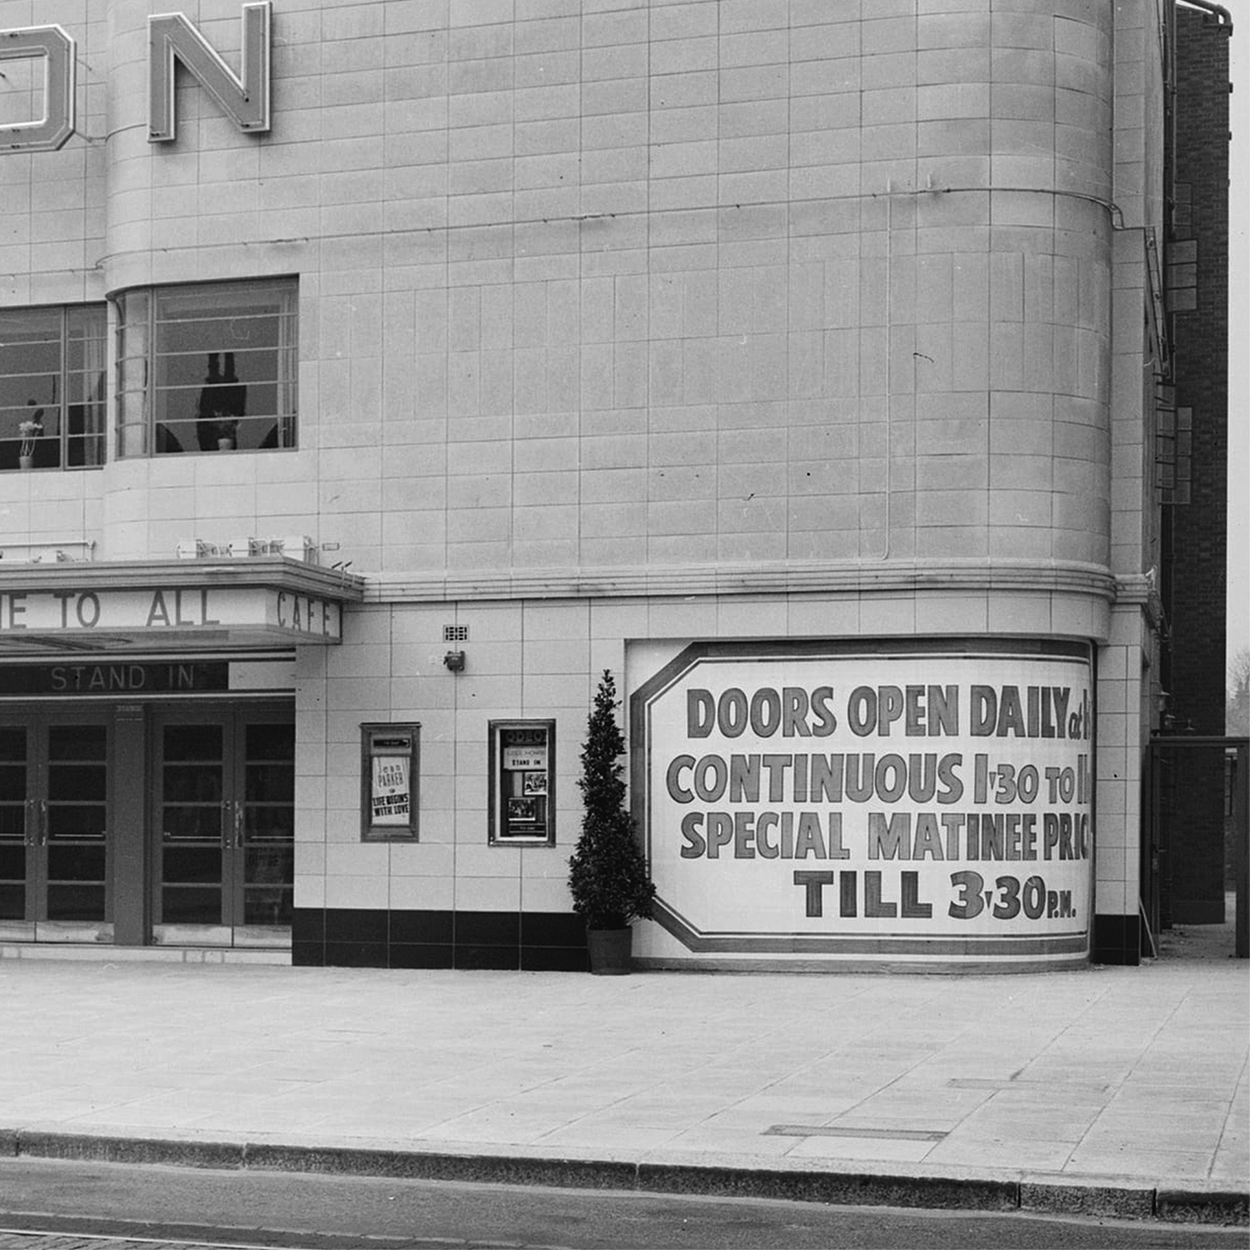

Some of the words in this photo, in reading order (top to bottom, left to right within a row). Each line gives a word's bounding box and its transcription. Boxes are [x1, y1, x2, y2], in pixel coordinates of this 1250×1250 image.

[53, 591, 101, 629] TO
[145, 589, 220, 628] ALL
[277, 591, 330, 637] CAFE
[686, 686, 837, 739] DOORS
[848, 684, 959, 738] OPEN
[970, 684, 1071, 739] DAILY
[666, 753, 964, 804] CONTINUOUS
[1044, 766, 1076, 804] TO
[680, 811, 850, 860] SPECIAL
[867, 812, 1038, 861] MATINEE
[793, 870, 933, 919] TILL
